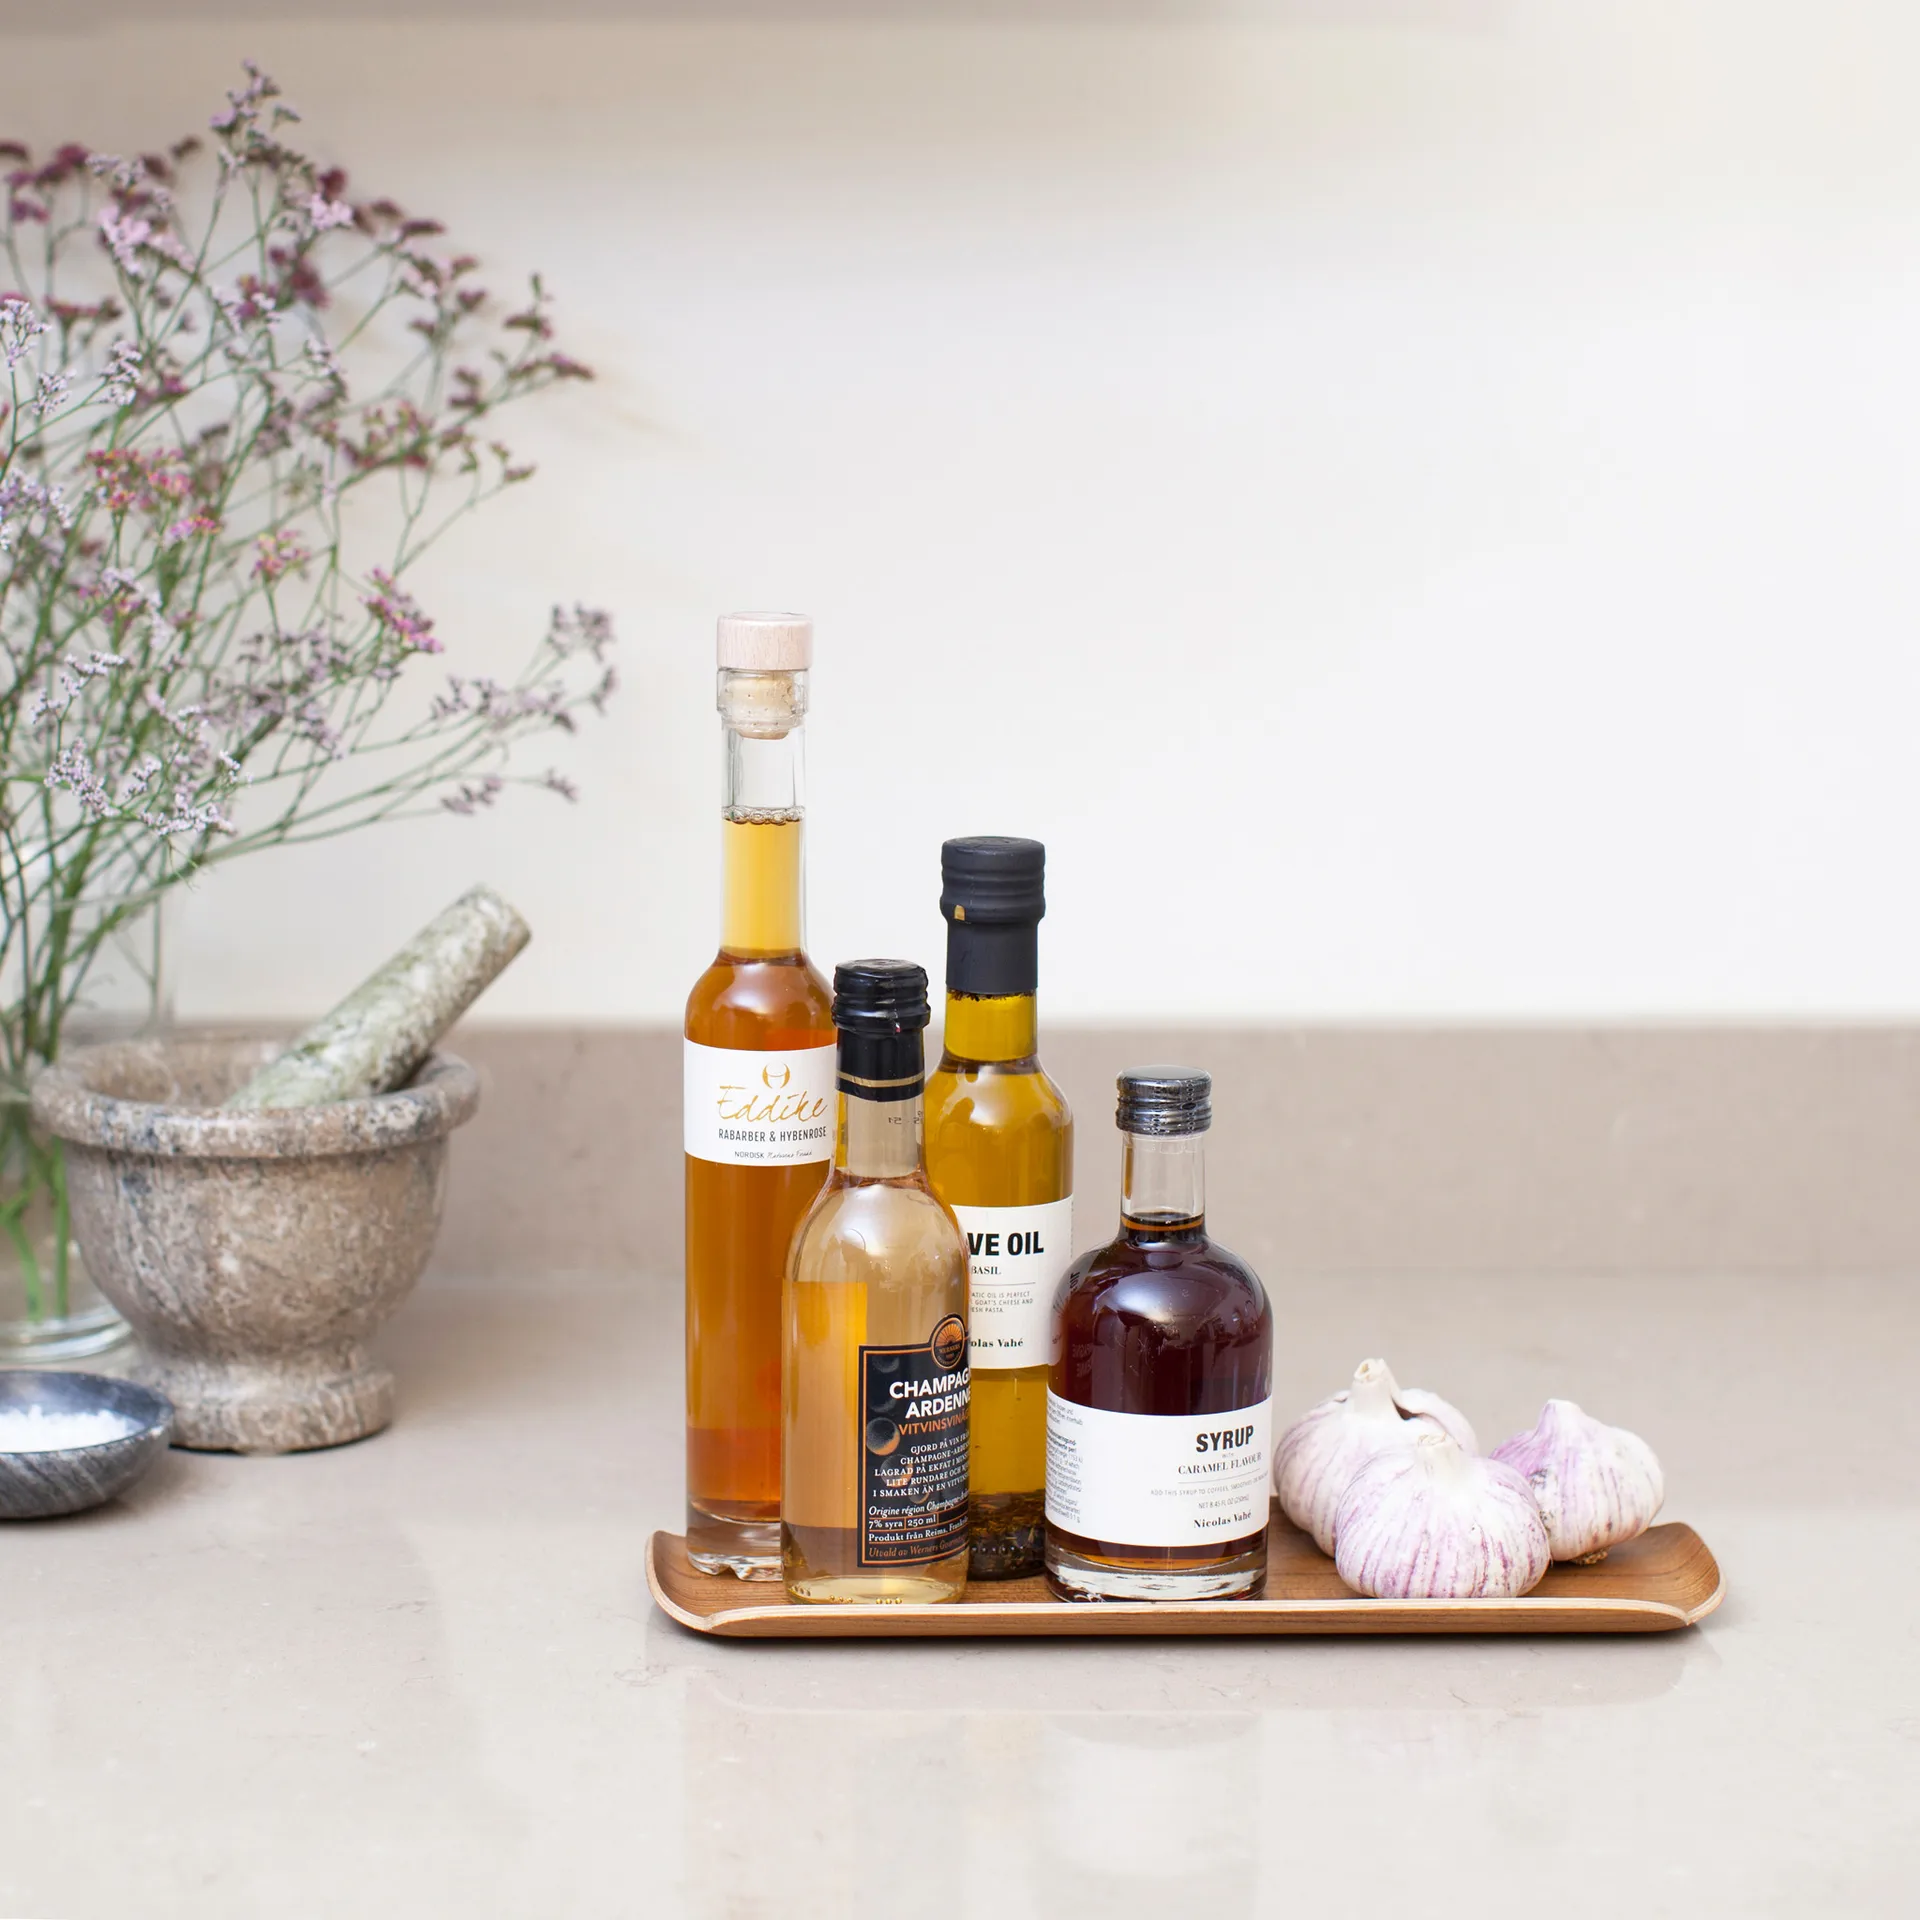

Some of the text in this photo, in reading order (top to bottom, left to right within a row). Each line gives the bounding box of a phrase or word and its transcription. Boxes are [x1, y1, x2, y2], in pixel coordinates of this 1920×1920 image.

[717, 1086, 828, 1123] Eddike
[718, 1126, 827, 1142] RABARBER & HYBENROSE
[734, 1151, 764, 1159] NORDISK
[967, 1232, 1000, 1256] VE
[1007, 1231, 1044, 1256] OIL
[971, 1266, 1001, 1275] BASIL
[970, 1338, 1024, 1347] olas Vahé
[889, 1368, 970, 1399] CHAMPAG
[910, 1443, 938, 1455] GJORD
[940, 1438, 948, 1449] PÅ
[949, 1436, 960, 1446] VIN
[1196, 1425, 1254, 1453] SYRUP
[875, 1467, 914, 1477] LAGRAD
[916, 1464, 926, 1474] PÅ
[928, 1460, 951, 1472] EKFAT
[1178, 1452, 1261, 1475] CARAMEL FLAVOUR
[886, 1477, 908, 1487] LITE
[910, 1471, 948, 1485] RUNDARE
[949, 1466, 961, 1476] OCH
[880, 1487, 920, 1497] SMAKEN
[922, 1485, 934, 1494] ÄN
[936, 1482, 946, 1491] EN
[869, 1506, 900, 1518] Origine
[901, 1503, 925, 1516] région
[1199, 1501, 1208, 1509] NET
[869, 1520, 903, 1530] 7% syra
[908, 1514, 936, 1527] 250 ml
[1194, 1509, 1252, 1528] Nicolas Vahé
[868, 1532, 904, 1542] Produkt
[906, 1531, 923, 1540] från
[869, 1546, 897, 1558] Utvald
